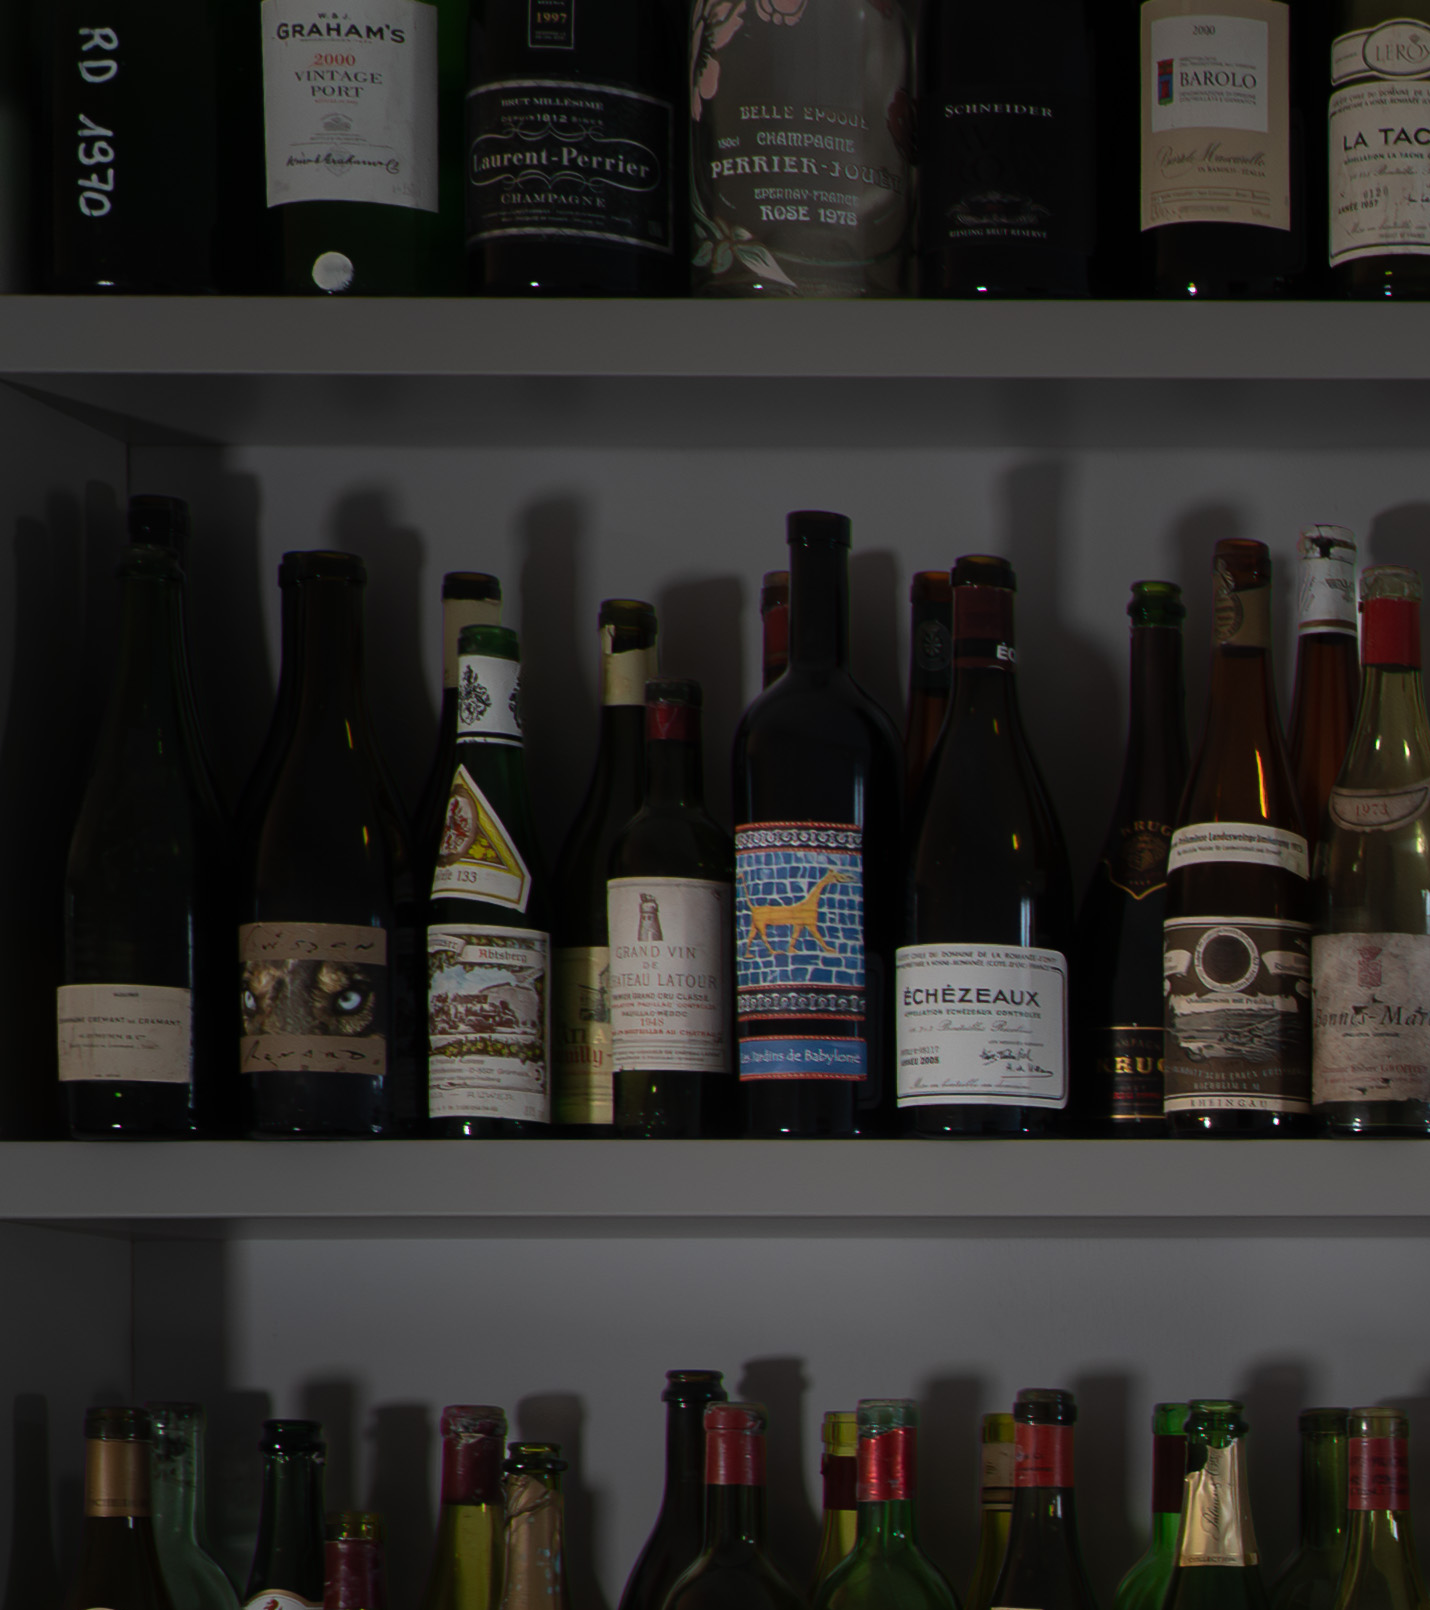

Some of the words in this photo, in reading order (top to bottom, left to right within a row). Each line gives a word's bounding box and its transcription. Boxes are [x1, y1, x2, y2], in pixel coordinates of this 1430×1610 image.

[536, 11, 568, 24] 1997
[276, 22, 406, 44] GRAHAM'S
[79, 26, 119, 84] RD
[314, 54, 356, 66] 2000
[294, 71, 382, 85] VINTAGE
[1179, 70, 1257, 89] BAROLO
[310, 84, 364, 98] PORT
[944, 104, 1054, 119] SCHNEIDER
[1342, 130, 1369, 149] LA
[78, 113, 116, 218] 1970
[500, 192, 606, 208] CHAMPAGNE
[657, 974, 718, 989] LATOUR
[904, 983, 1040, 1008] ÉCHÉZEAUX
